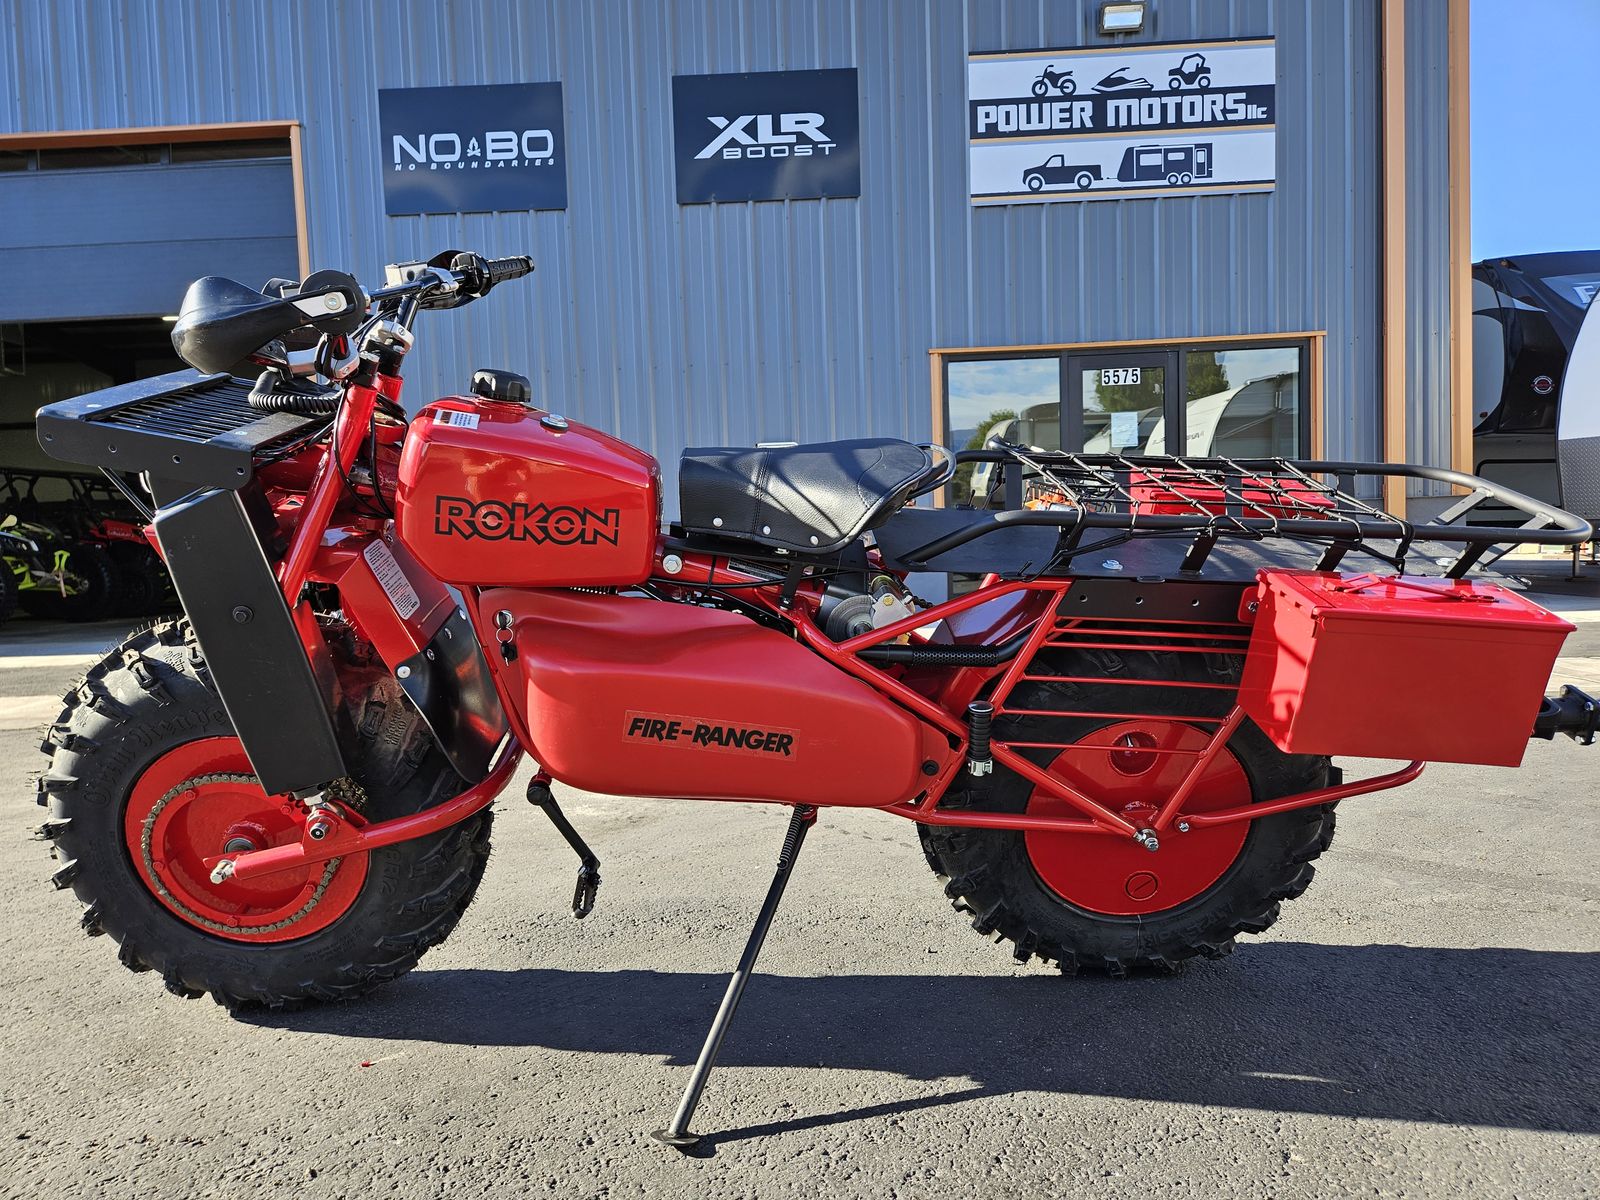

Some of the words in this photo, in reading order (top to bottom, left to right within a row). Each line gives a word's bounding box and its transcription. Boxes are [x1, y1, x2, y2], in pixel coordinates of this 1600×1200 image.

[977, 101, 1094, 133] POWER
[1106, 92, 1246, 127] MOTORS
[693, 112, 832, 159] XLR
[723, 143, 837, 159] BOOST
[394, 163, 416, 171] NO
[430, 158, 555, 170] BOUNDARIES
[1103, 369, 1139, 385] 5575
[435, 495, 620, 546] ROKON
[627, 717, 794, 757] FIRE-RANGER
